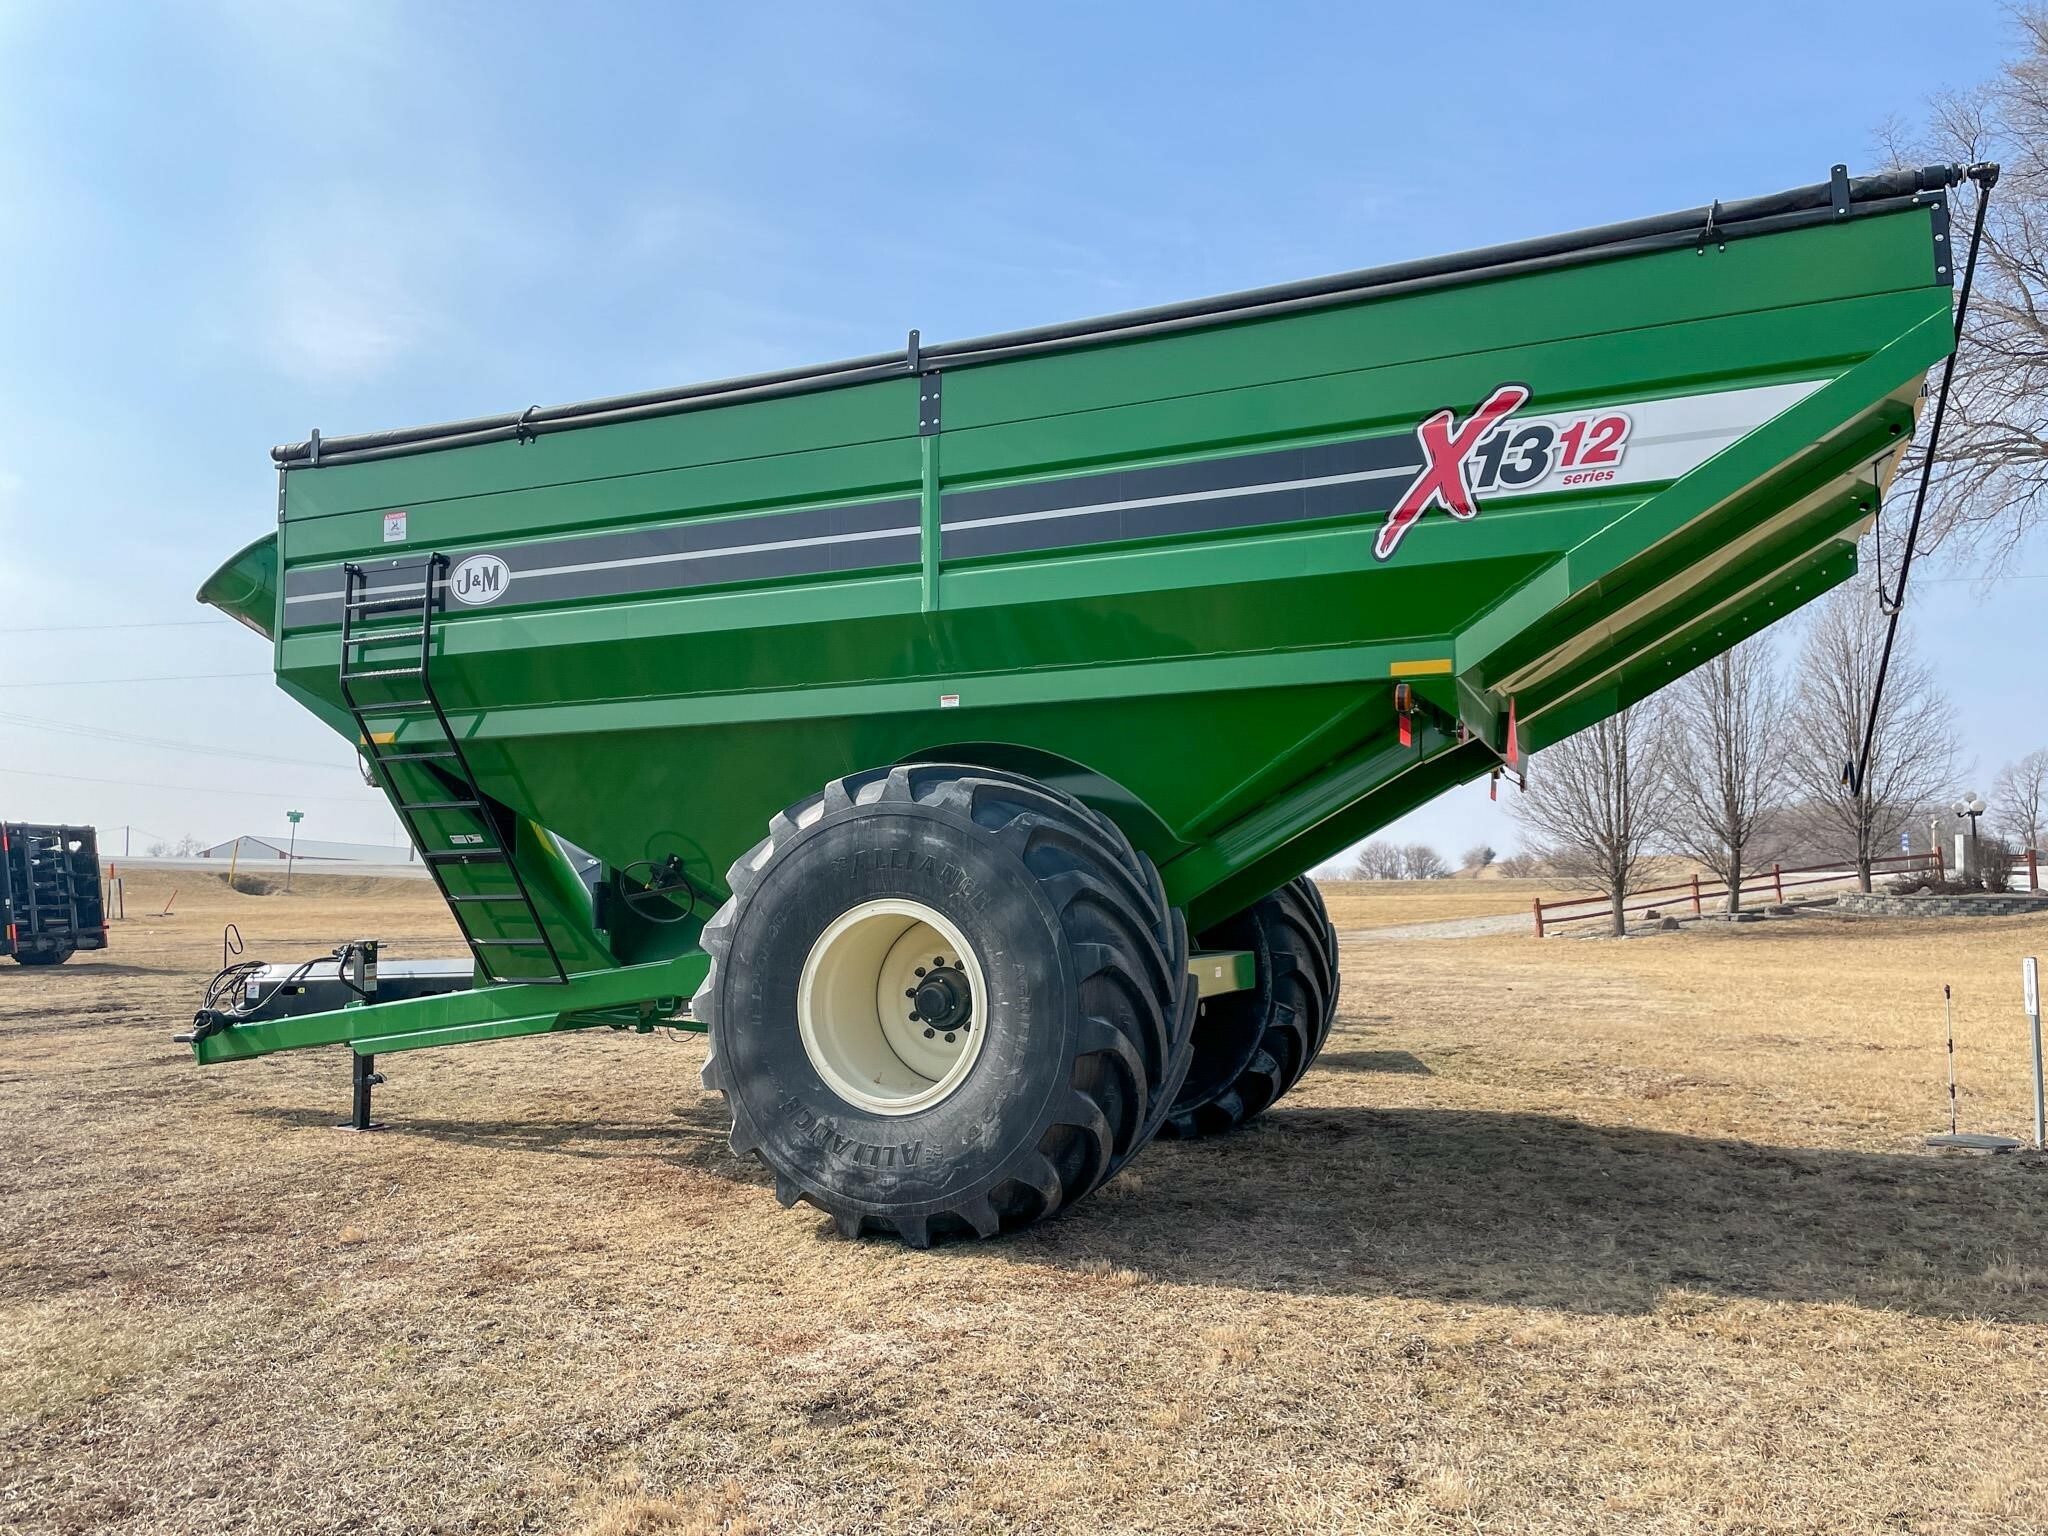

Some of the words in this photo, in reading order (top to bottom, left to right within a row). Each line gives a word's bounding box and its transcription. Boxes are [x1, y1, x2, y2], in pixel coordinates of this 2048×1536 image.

[1562, 469, 1615, 485] series
[456, 565, 501, 595] J&M
[778, 1095, 923, 1169] ALLIANCE
